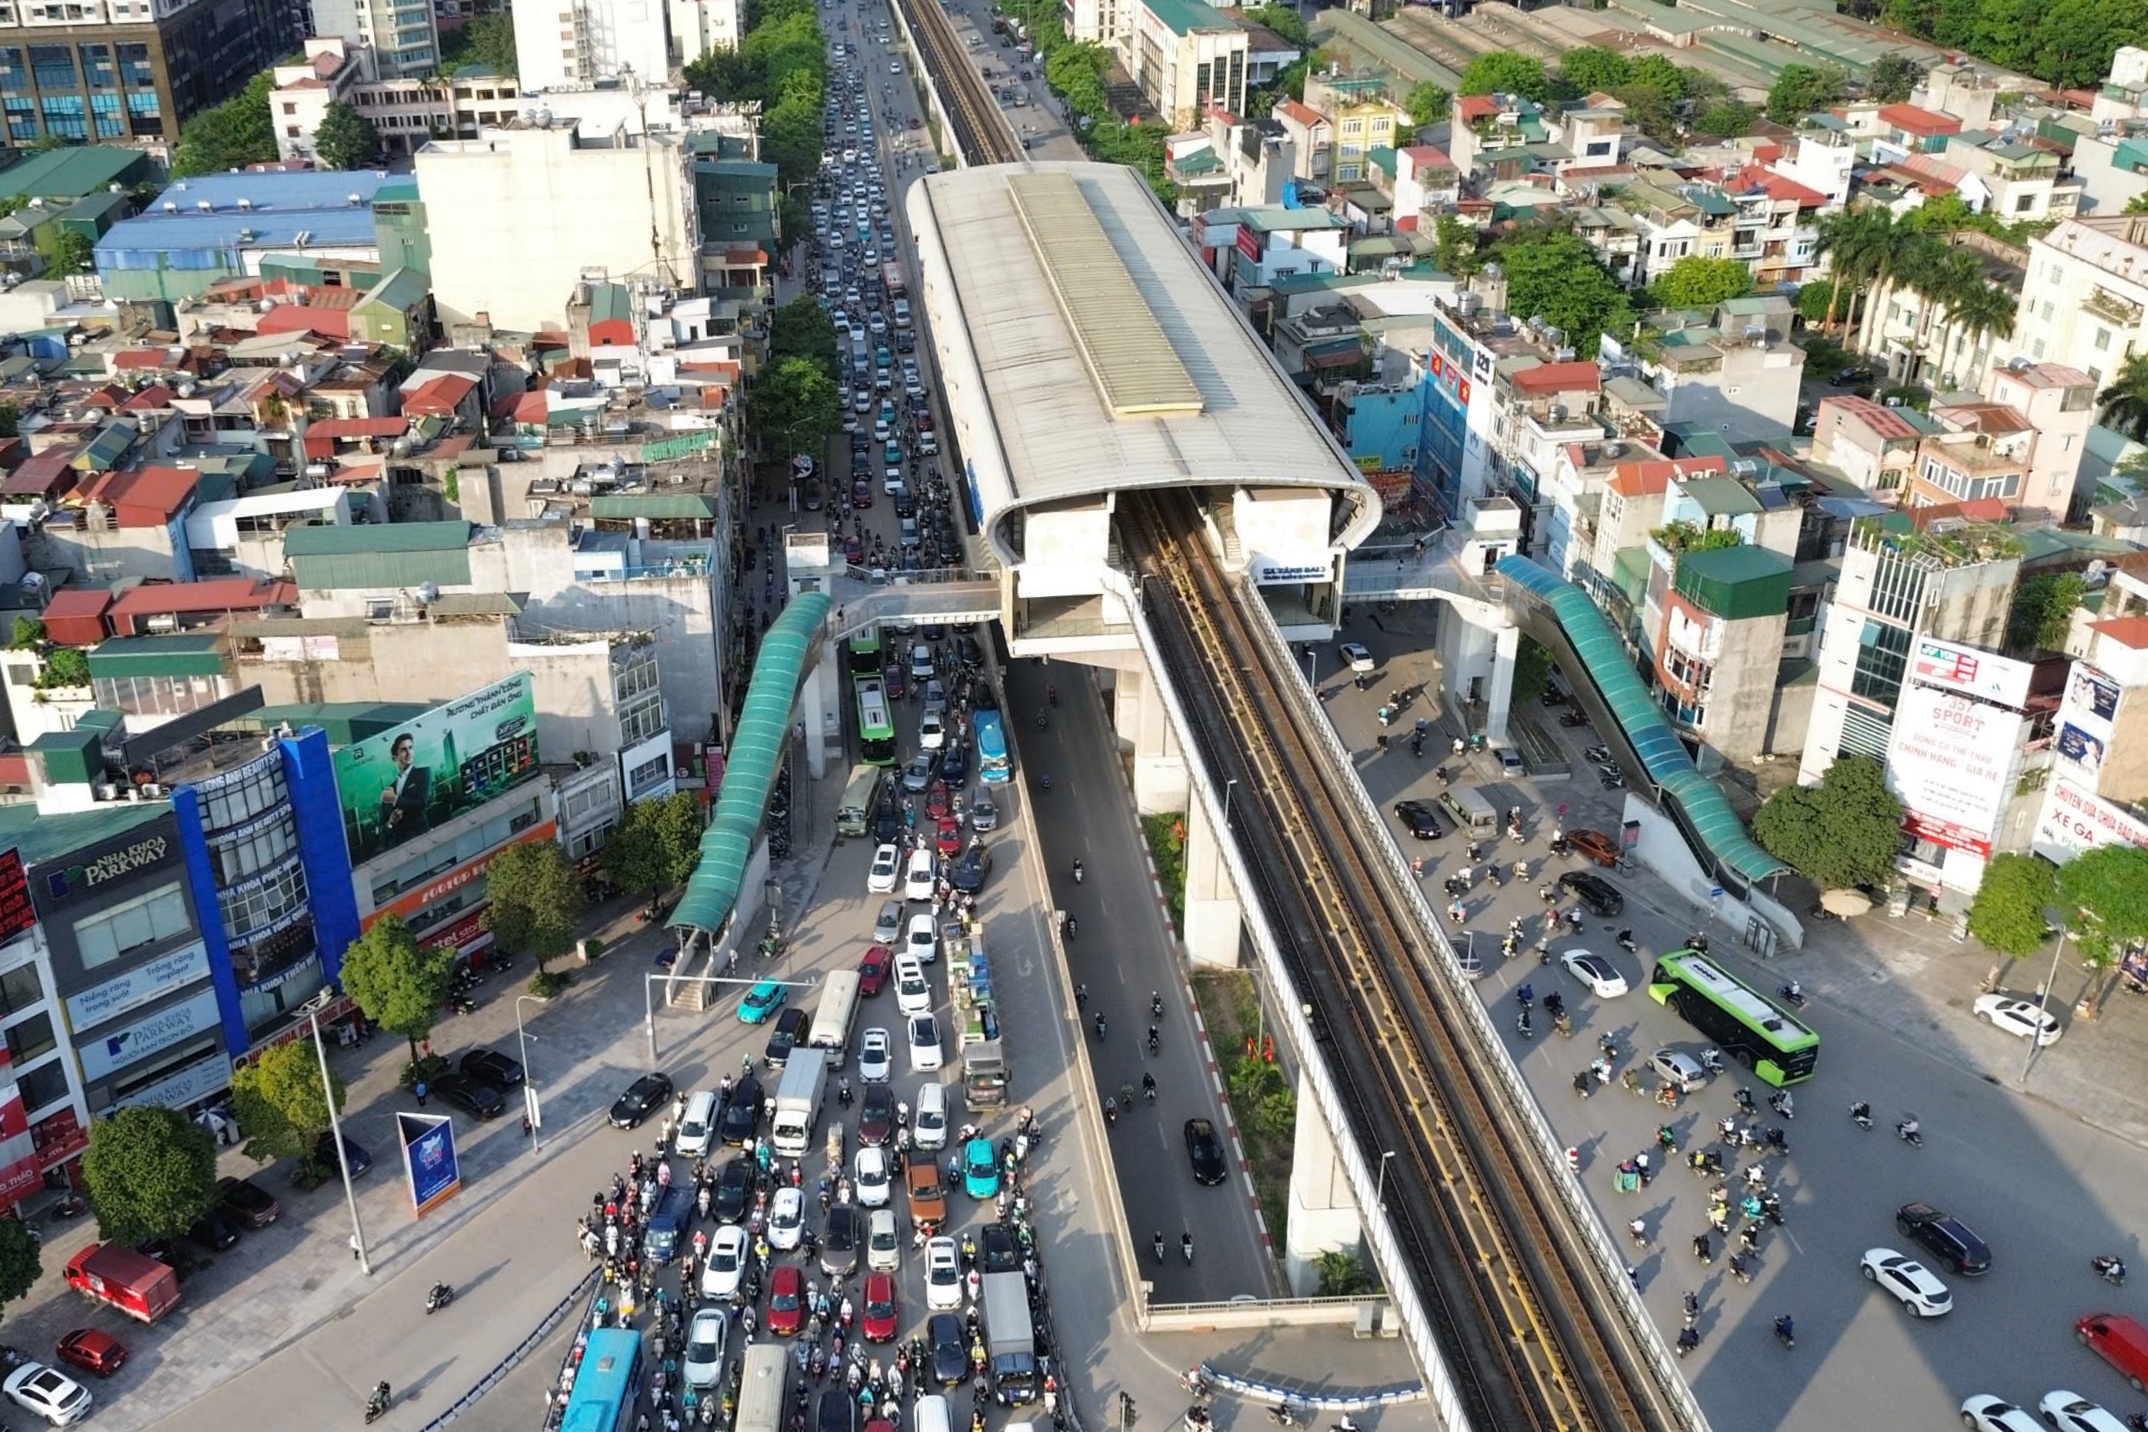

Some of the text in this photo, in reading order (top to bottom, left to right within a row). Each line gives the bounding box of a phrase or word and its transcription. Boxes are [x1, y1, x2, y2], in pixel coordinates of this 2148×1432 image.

[1932, 707, 1985, 732] SPORT
[2052, 808, 2070, 827] XE
[2074, 822, 2093, 843] GA
[84, 843, 168, 887] PARKWAY
[97, 836, 167, 869] NHA KHOA
[216, 886, 236, 900] NHA
[237, 877, 261, 894] KHOA
[228, 938, 247, 951] NHA
[249, 928, 272, 944] KHOA
[85, 1000, 109, 1014] trong
[156, 963, 189, 983] implant
[240, 986, 259, 1000] NHA
[261, 975, 284, 993] KHOA
[133, 1012, 192, 1047] PARKWAY
[9, 1168, 33, 1187] THẢO
